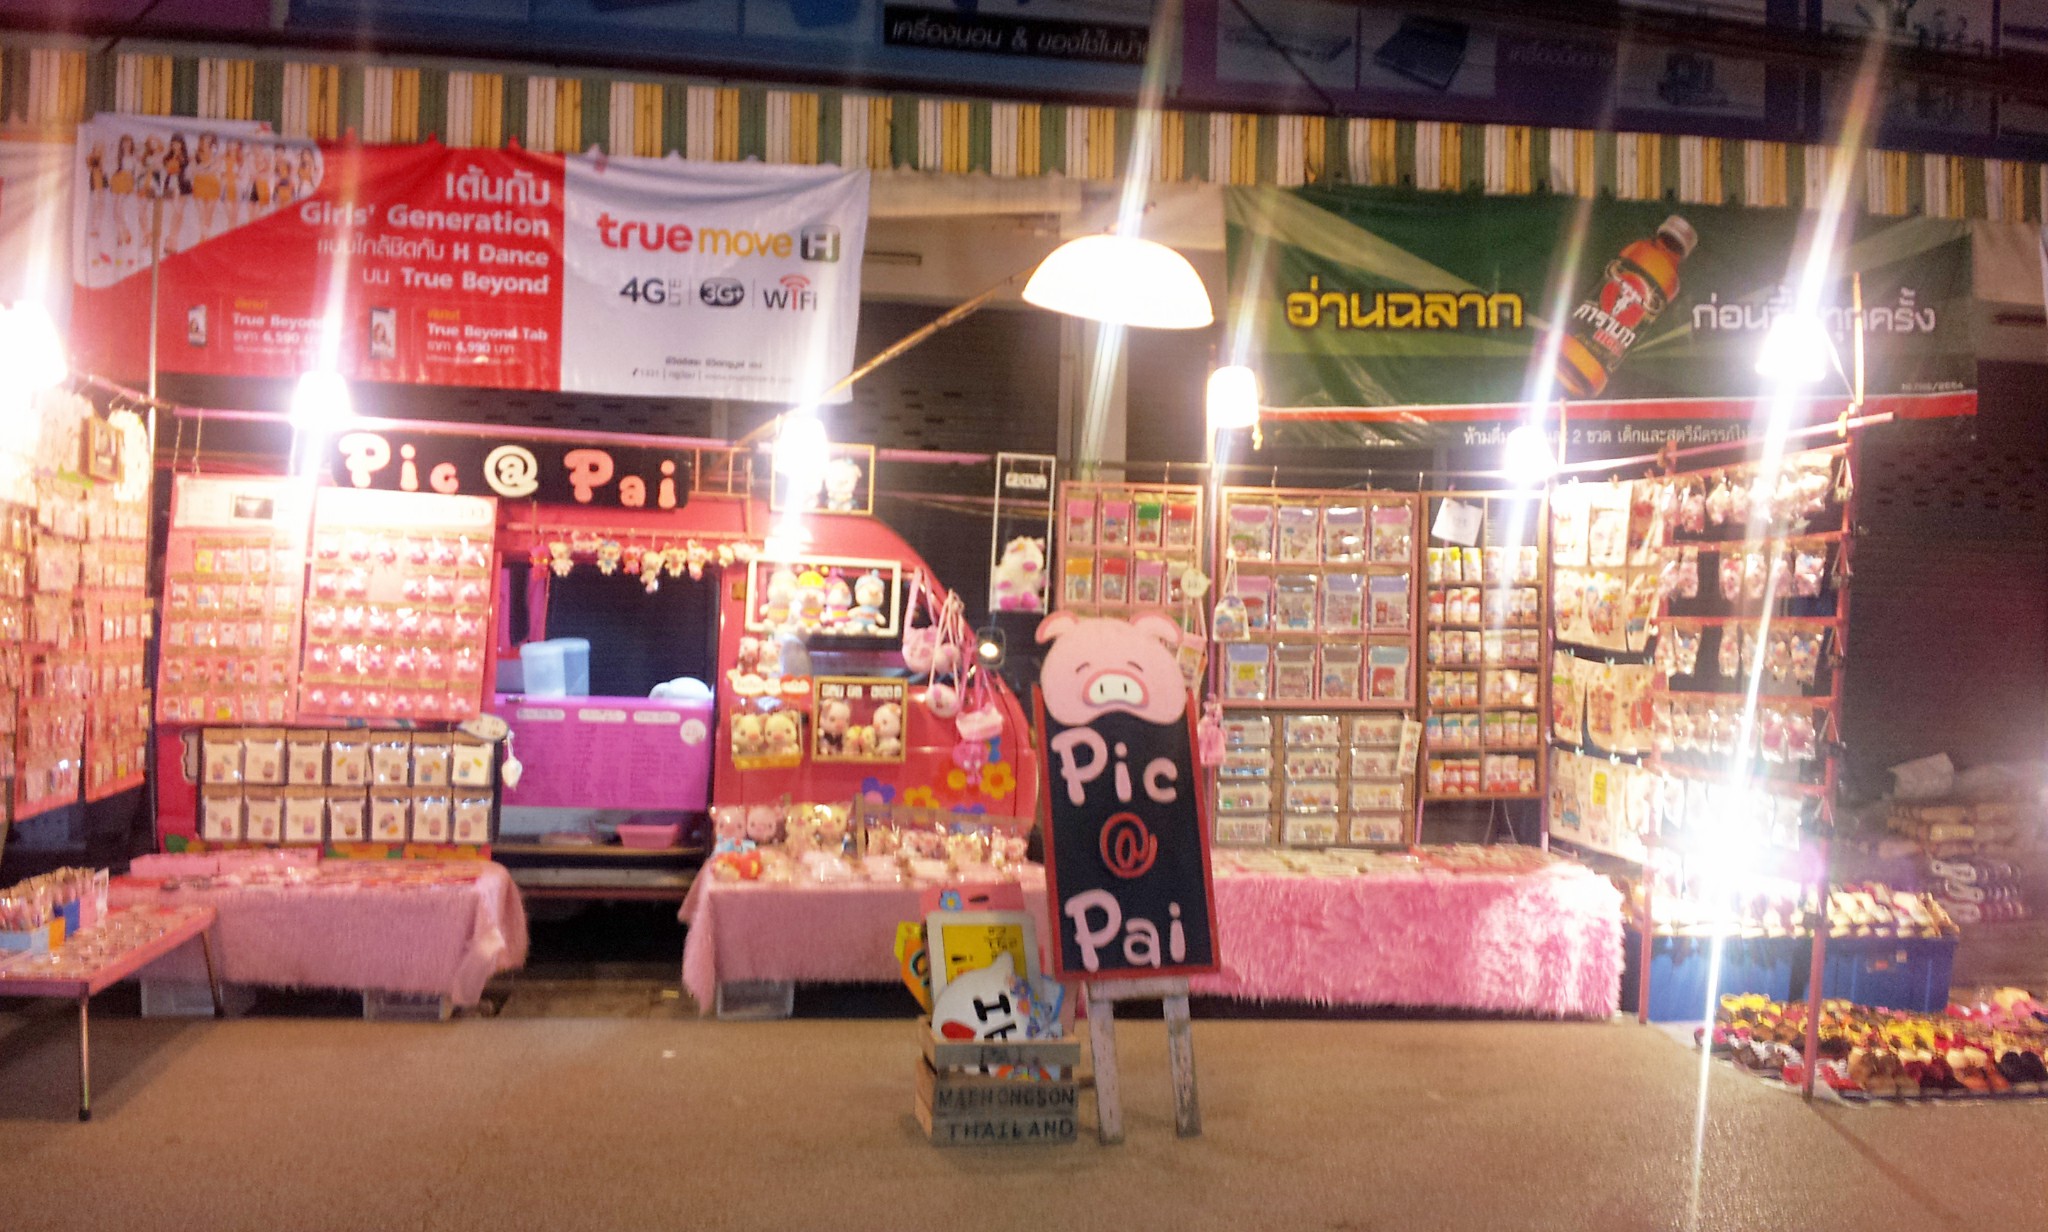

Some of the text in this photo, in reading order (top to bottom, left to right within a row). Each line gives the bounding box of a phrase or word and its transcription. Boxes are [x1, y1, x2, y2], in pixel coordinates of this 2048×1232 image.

[1011, 26, 1028, 50] &
[1037, 28, 1150, 57] ของใช้ในบ้า
[446, 164, 550, 207] เต้นกับ
[387, 203, 549, 239] Generation
[453, 242, 470, 262] H
[478, 243, 549, 267] Dance
[362, 267, 549, 296] บน True Beyond
[620, 276, 667, 305] 4G
[1286, 275, 1523, 329] อ่านฉลาก
[233, 313, 326, 330] True Beyon
[427, 322, 548, 341] True Beyond Tab
[1572, 429, 1582, 444] 2
[1587, 428, 1612, 444] ขวด
[337, 431, 677, 510] Pic @ Pai
[1051, 726, 1178, 807] Pic
[1099, 811, 1158, 879] @
[1064, 888, 1187, 973] Pai
[949, 1118, 1075, 1140] THAILAND
